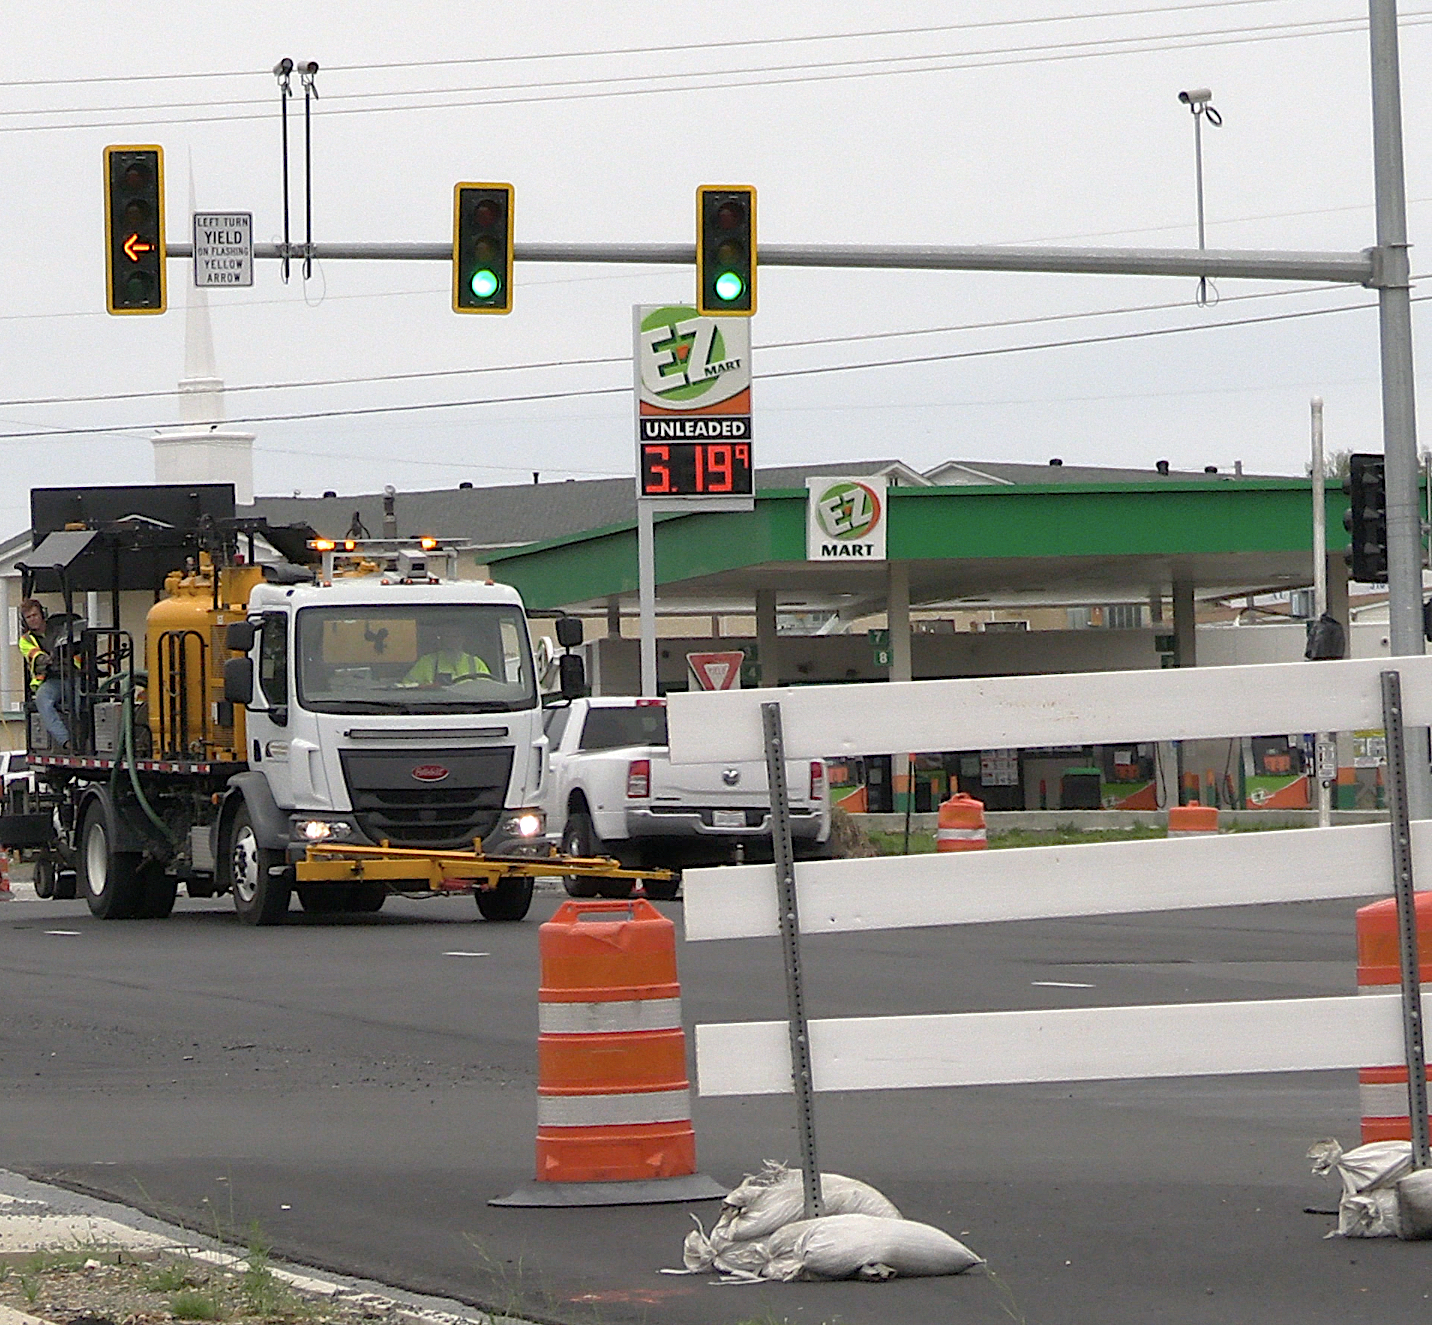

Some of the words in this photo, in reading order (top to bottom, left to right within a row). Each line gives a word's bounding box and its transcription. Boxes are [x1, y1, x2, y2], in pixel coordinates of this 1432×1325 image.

[197, 217, 219, 227] LEFT
[224, 217, 248, 227] TURN
[204, 231, 242, 244] YIELD
[198, 247, 208, 256] ON
[211, 247, 249, 256] FLASHING
[204, 259, 243, 269] YELLOW
[207, 273, 240, 283] ARROW
[640, 315, 720, 396] EZ
[704, 359, 742, 377] MART
[646, 421, 746, 437] UNLEADED
[819, 487, 873, 536] EZ
[821, 544, 874, 557] MART
[879, 652, 888, 664] 8
